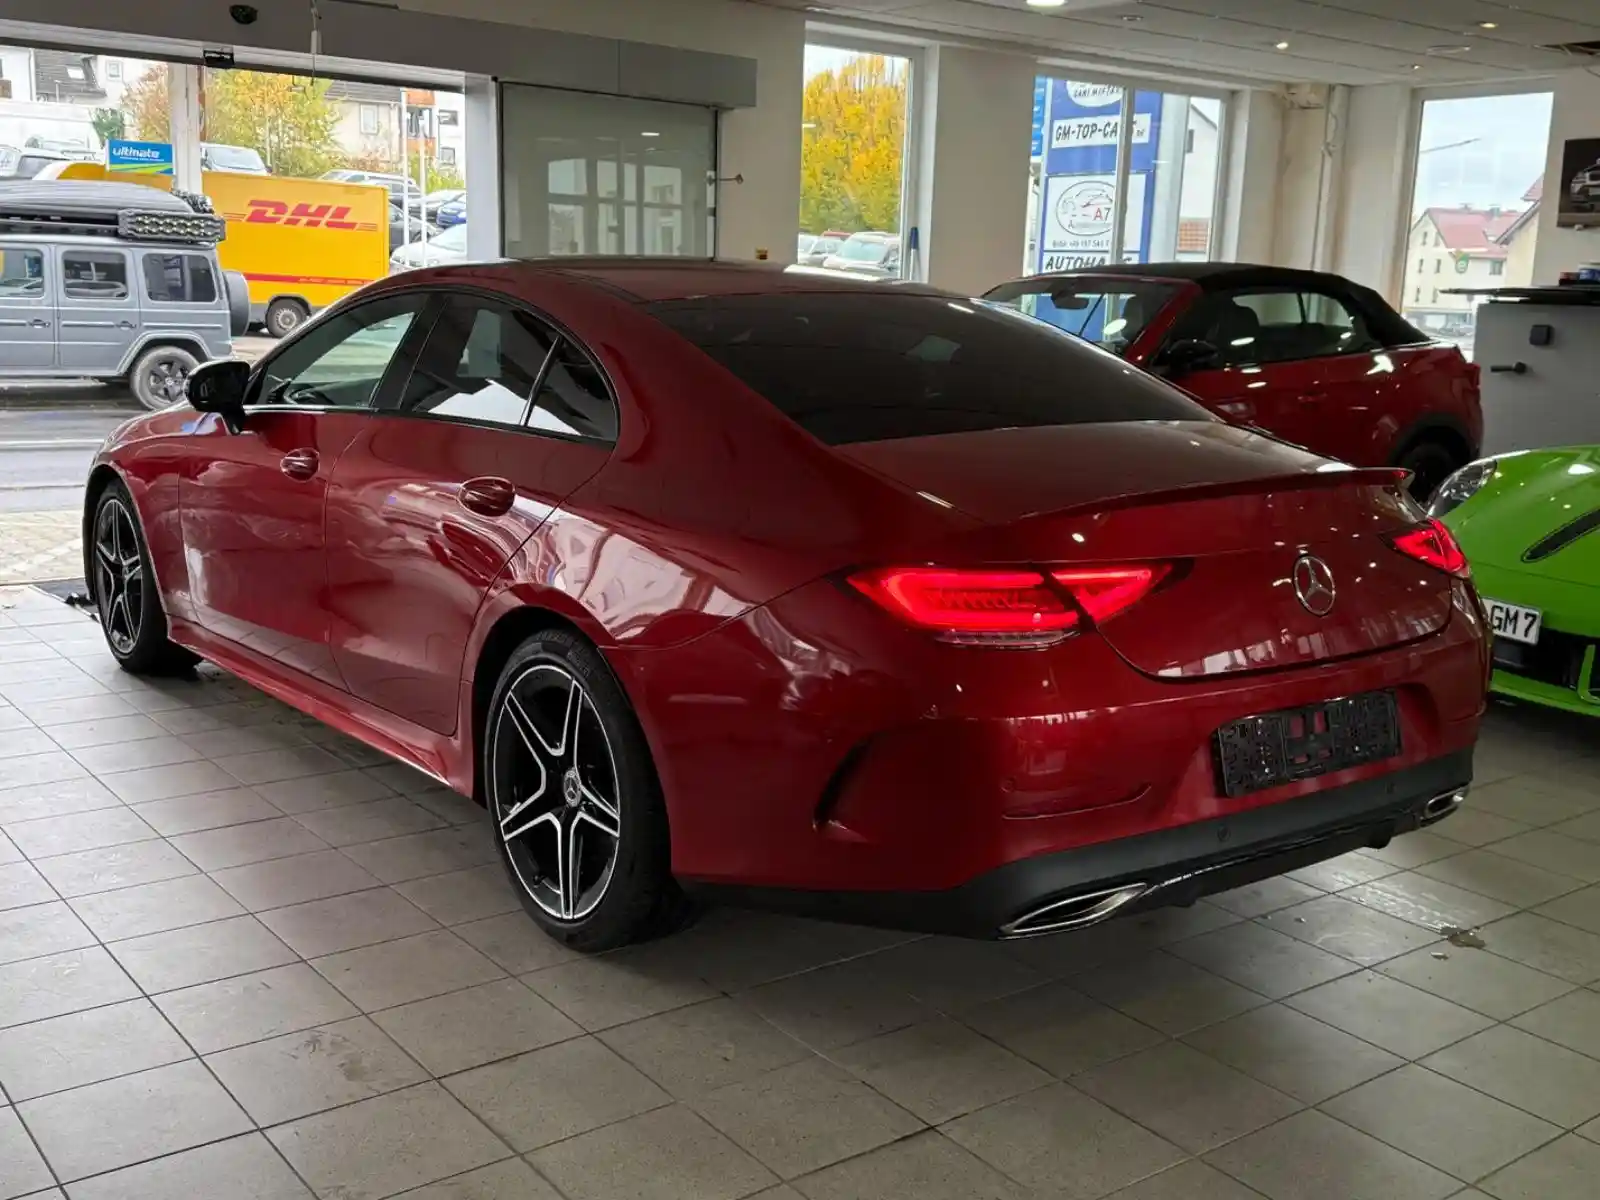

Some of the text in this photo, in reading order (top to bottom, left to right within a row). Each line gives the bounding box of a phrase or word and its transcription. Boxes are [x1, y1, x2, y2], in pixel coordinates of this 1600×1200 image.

[112, 146, 160, 159] ultimate
[247, 200, 358, 230] DHL
[1490, 604, 1537, 638] GM 7
